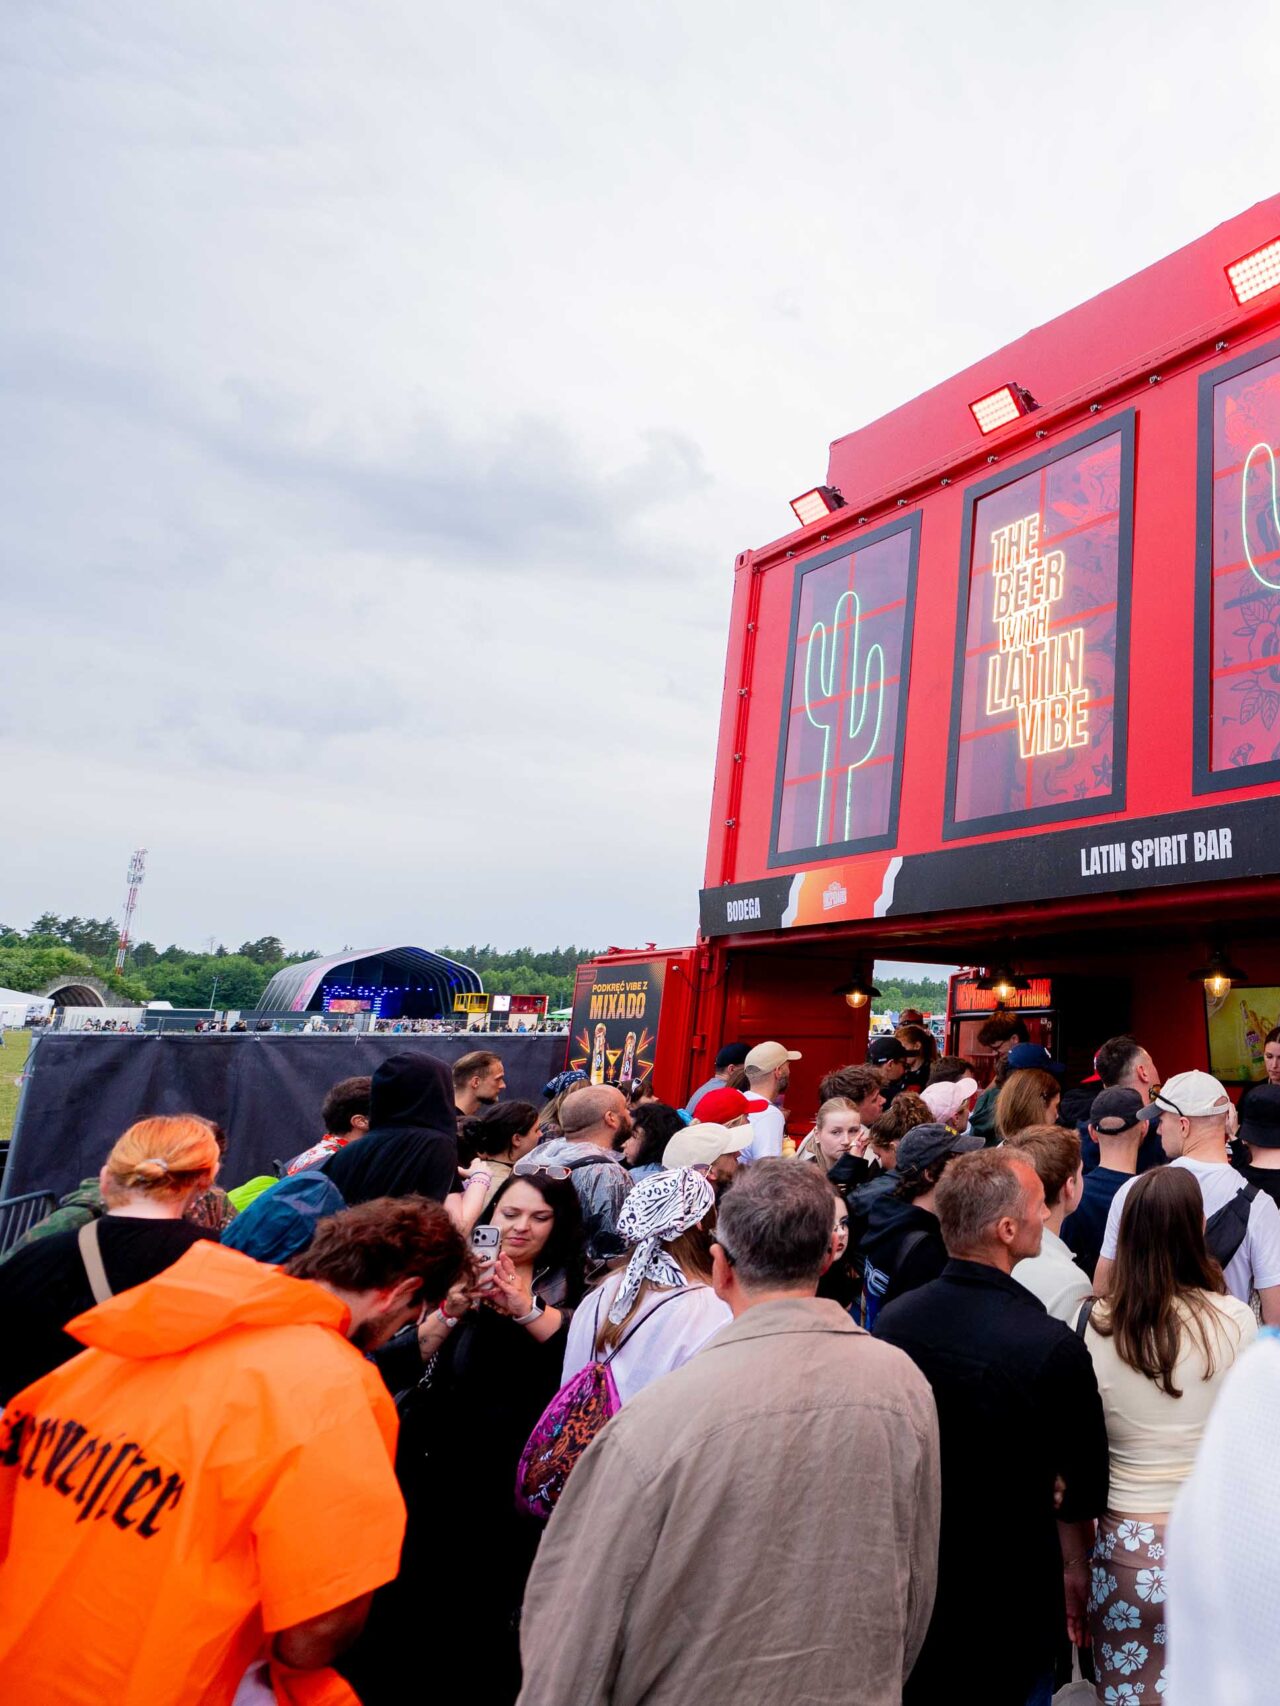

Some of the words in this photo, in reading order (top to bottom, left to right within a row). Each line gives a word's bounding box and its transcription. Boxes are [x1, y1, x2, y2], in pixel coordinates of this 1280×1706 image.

[991, 513, 1040, 577] THE
[993, 550, 1066, 623] BEER
[999, 602, 1050, 654] WITH
[986, 628, 1084, 715] LATIN
[1017, 688, 1089, 759] VIBE
[1080, 843, 1127, 877] LATIN
[1131, 833, 1188, 871] SPIRIT
[1194, 827, 1233, 863] BAR
[726, 897, 761, 923] BODEGA
[589, 992, 646, 1020] MIXADO
[626, 981, 642, 992] VIBE
[643, 981, 648, 990] Z
